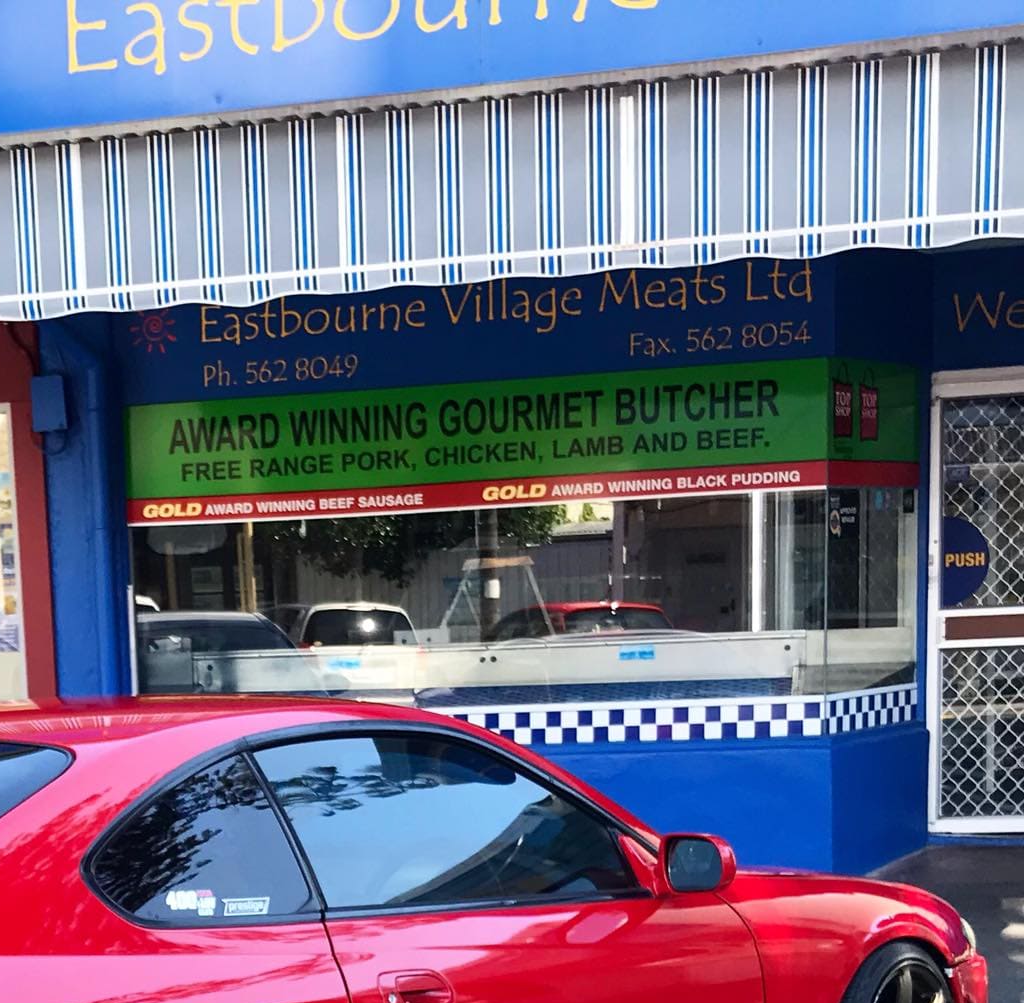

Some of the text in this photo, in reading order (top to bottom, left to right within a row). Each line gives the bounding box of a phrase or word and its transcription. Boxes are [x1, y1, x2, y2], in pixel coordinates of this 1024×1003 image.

[200, 259, 813, 345] Eastbourne Village Meats Ltd
[629, 320, 812, 357] Fax. 562 8054
[203, 354, 359, 388] Ph. 562 8049
[169, 379, 780, 455] AWARD WINNING GOURMET BUTCHER
[181, 426, 771, 482] FREE RANGE PORK, CHICKEN, LAMB AND BEEF.
[482, 470, 801, 502] GOLD AWARD WINNING BLACK PUDDING
[143, 493, 424, 519] GOLD AWARD WINNING BEEF SAUSAGE
[945, 552, 985, 567] PUSH
